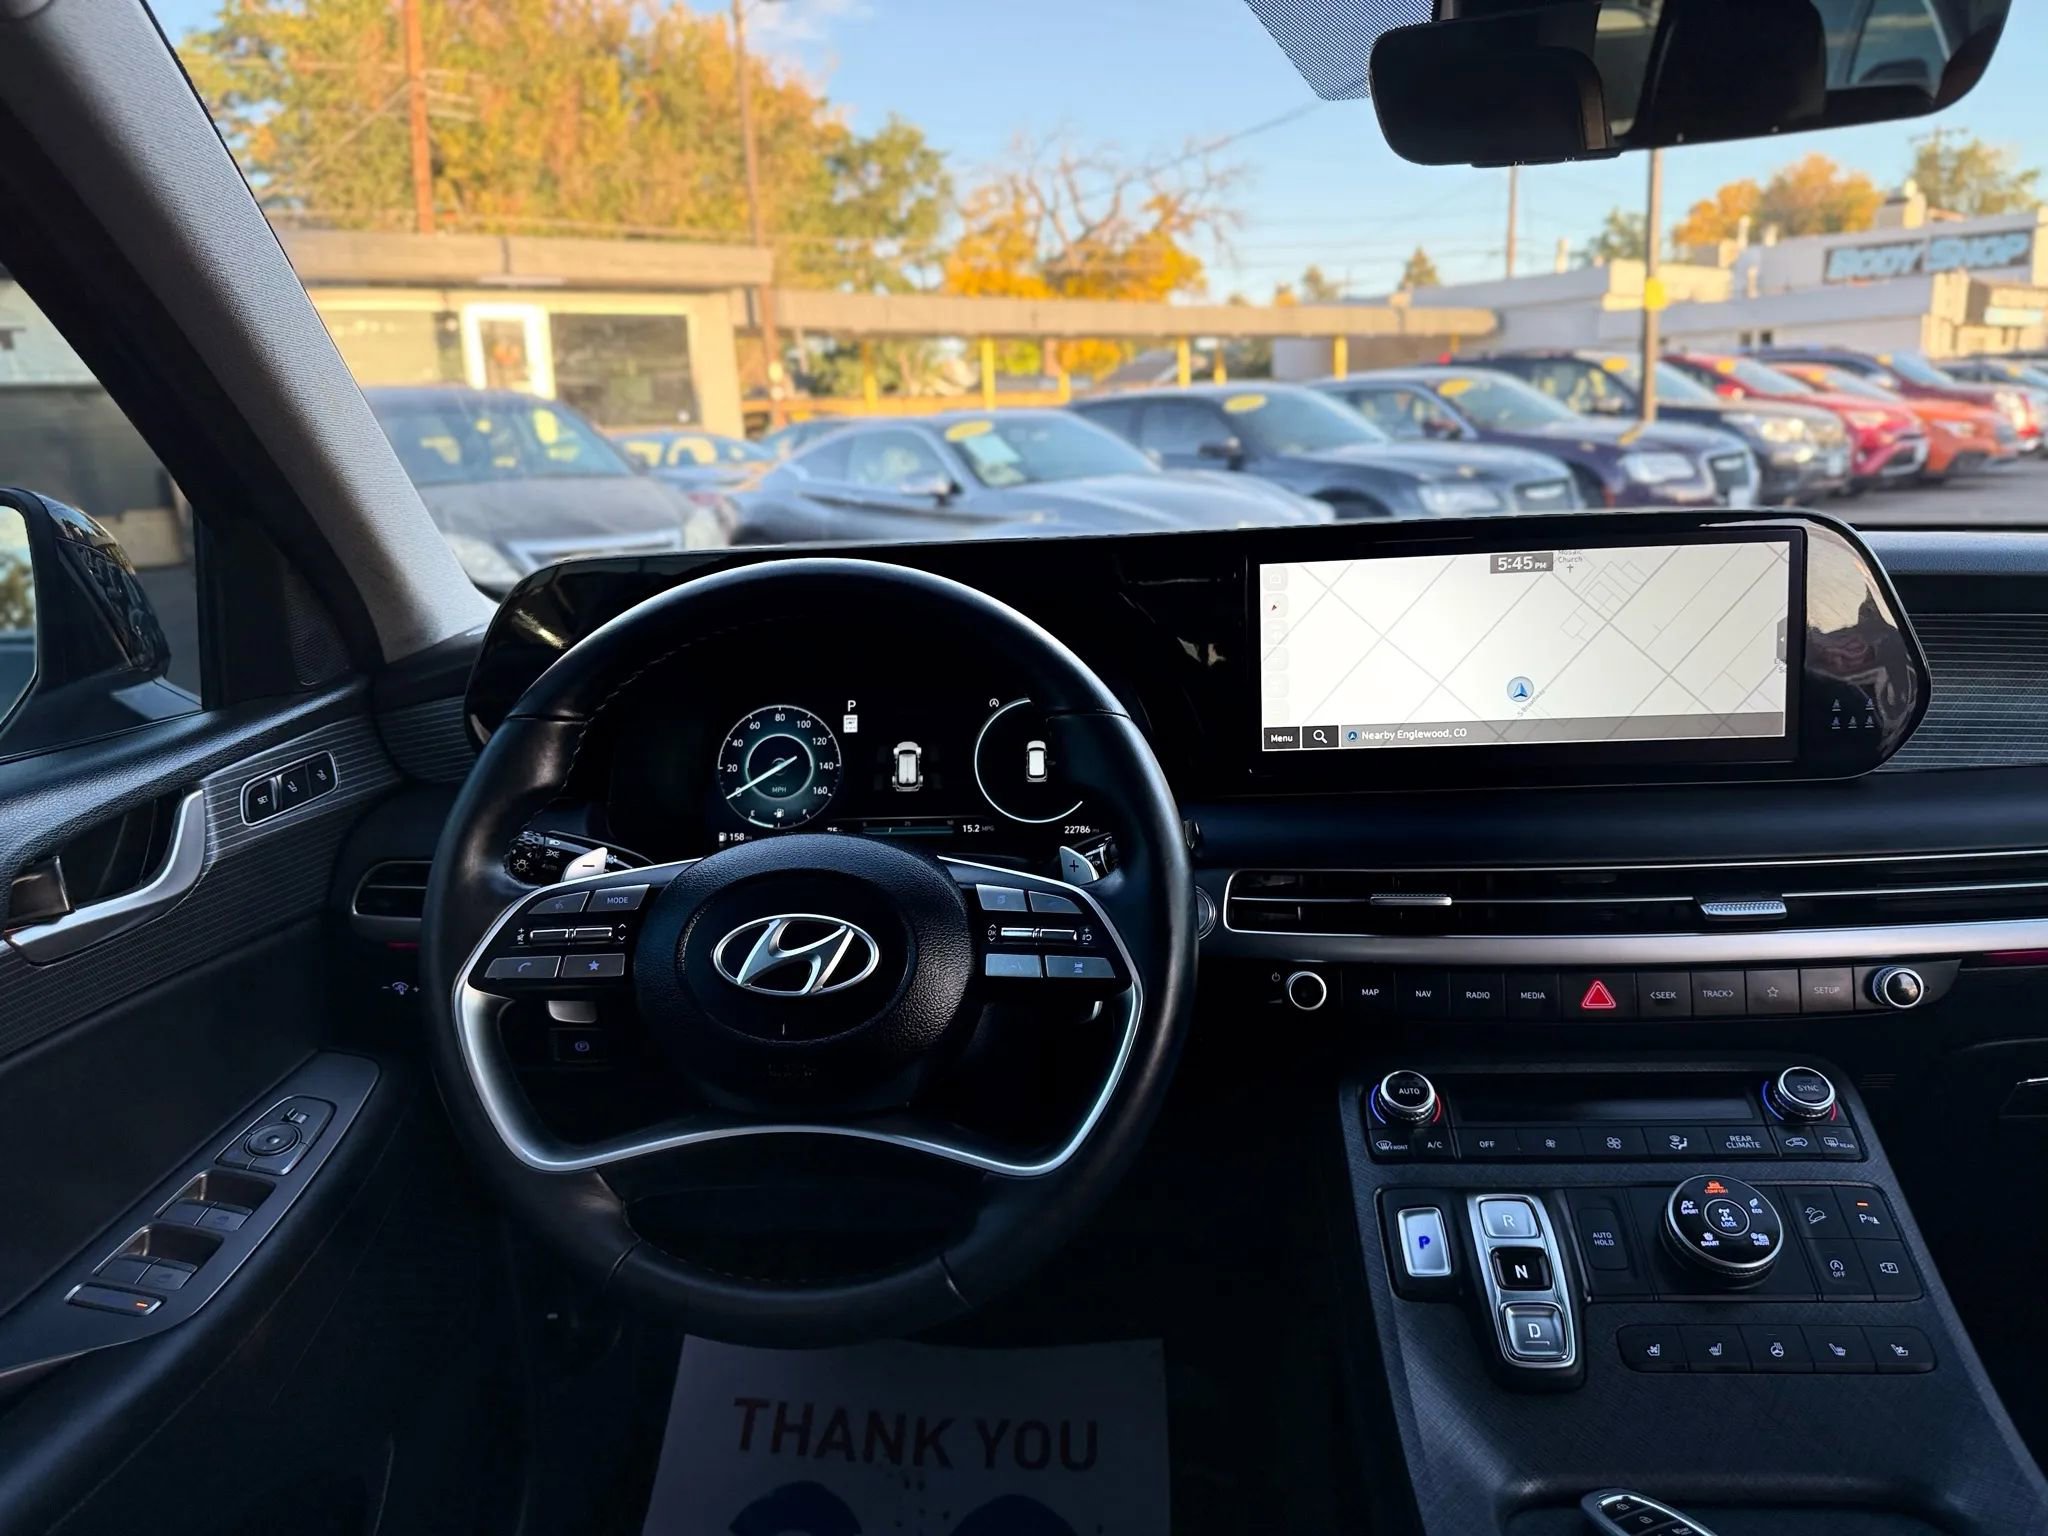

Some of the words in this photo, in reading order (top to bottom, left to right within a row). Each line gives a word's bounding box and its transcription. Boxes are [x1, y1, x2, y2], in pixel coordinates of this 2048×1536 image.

[1497, 555, 1533, 571] 5:45
[847, 699, 857, 712] P
[775, 713, 786, 722] 80
[749, 721, 760, 730] 60
[796, 720, 811, 729] 100
[1270, 734, 1293, 743] Menu
[1361, 731, 1395, 742] Nearby
[1454, 728, 1467, 737] CO
[732, 739, 744, 748] 40
[812, 737, 827, 746] 120
[726, 764, 738, 773] 20
[819, 762, 834, 771] 140
[813, 786, 828, 795] 160
[962, 824, 980, 833] 15.2
[1064, 825, 1091, 834] 22786
[729, 833, 745, 841] 158
[607, 896, 628, 904] MODE
[987, 929, 997, 937] OK
[1361, 988, 1380, 996] MAP
[1415, 990, 1432, 998] NAV
[1813, 986, 1840, 994] SETUP
[1465, 991, 1491, 999] RADIO
[1520, 991, 1546, 1000] MEDIA
[1398, 1087, 1420, 1095] AUTO
[1797, 1084, 1820, 1092] SYNC
[1427, 1141, 1443, 1149] A/C
[1726, 1141, 1761, 1149] CLIMATE
[1503, 1214, 1515, 1228] R
[1418, 1235, 1431, 1249] P
[1515, 1264, 1528, 1279] N
[1527, 1323, 1541, 1338] D
[734, 1396, 956, 1469] THANK
[976, 1417, 1099, 1471] YOU
